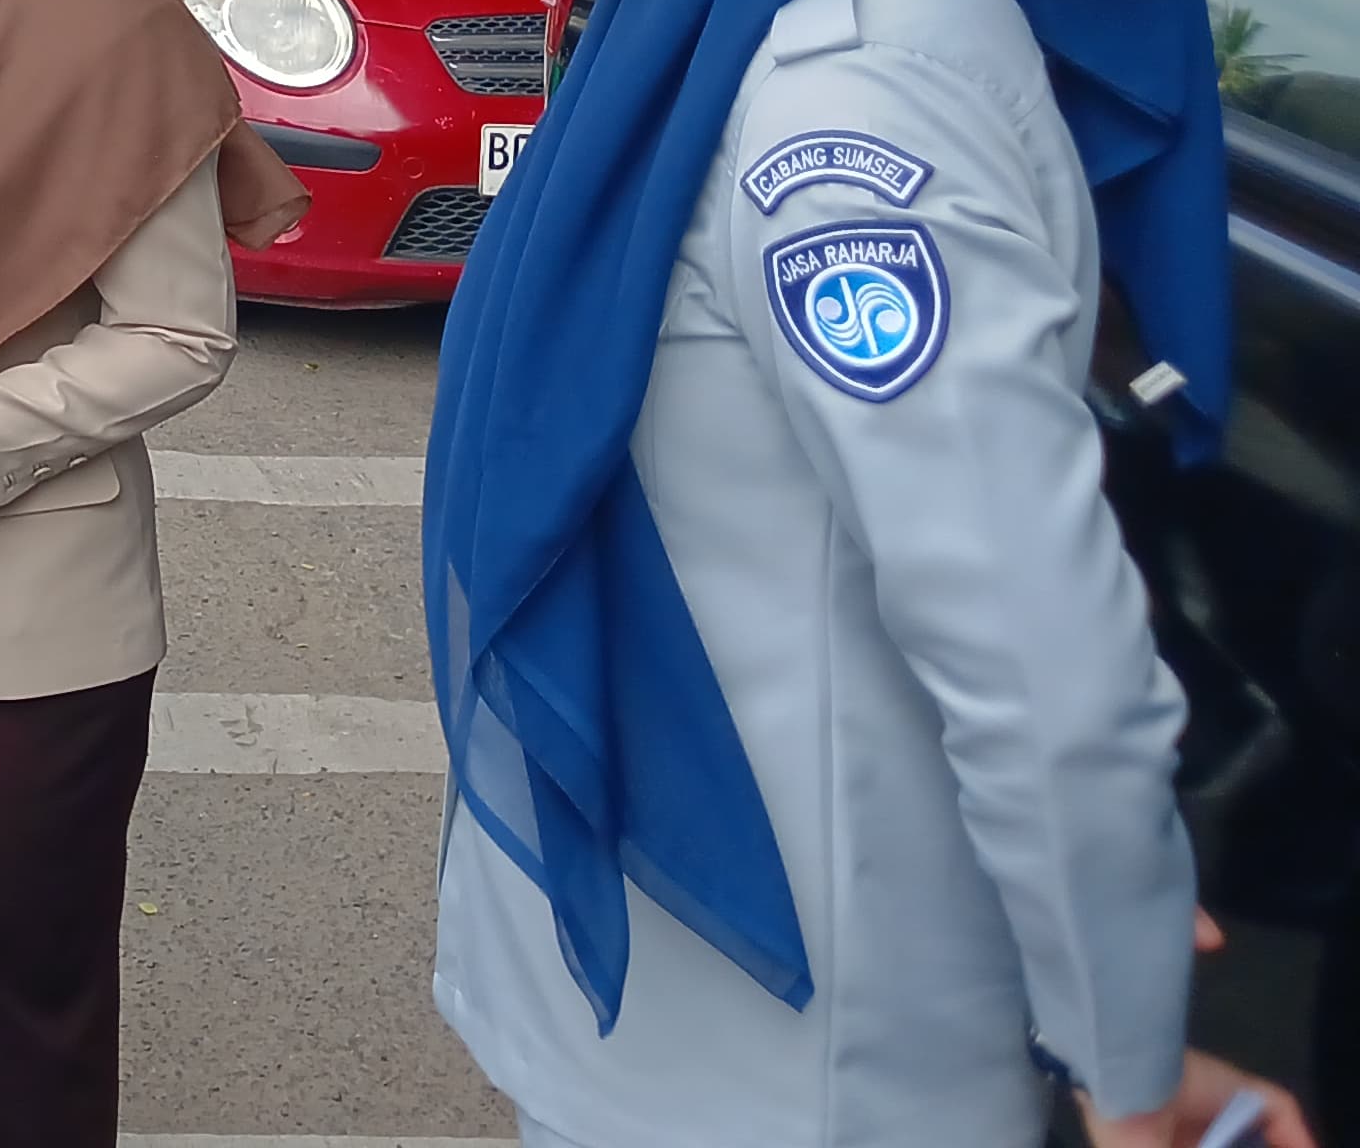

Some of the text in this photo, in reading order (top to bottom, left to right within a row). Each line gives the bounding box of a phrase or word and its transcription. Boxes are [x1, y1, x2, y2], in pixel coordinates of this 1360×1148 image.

[759, 146, 905, 193] CABANG SUMSEL
[781, 241, 918, 283] JASA RAHARJA
